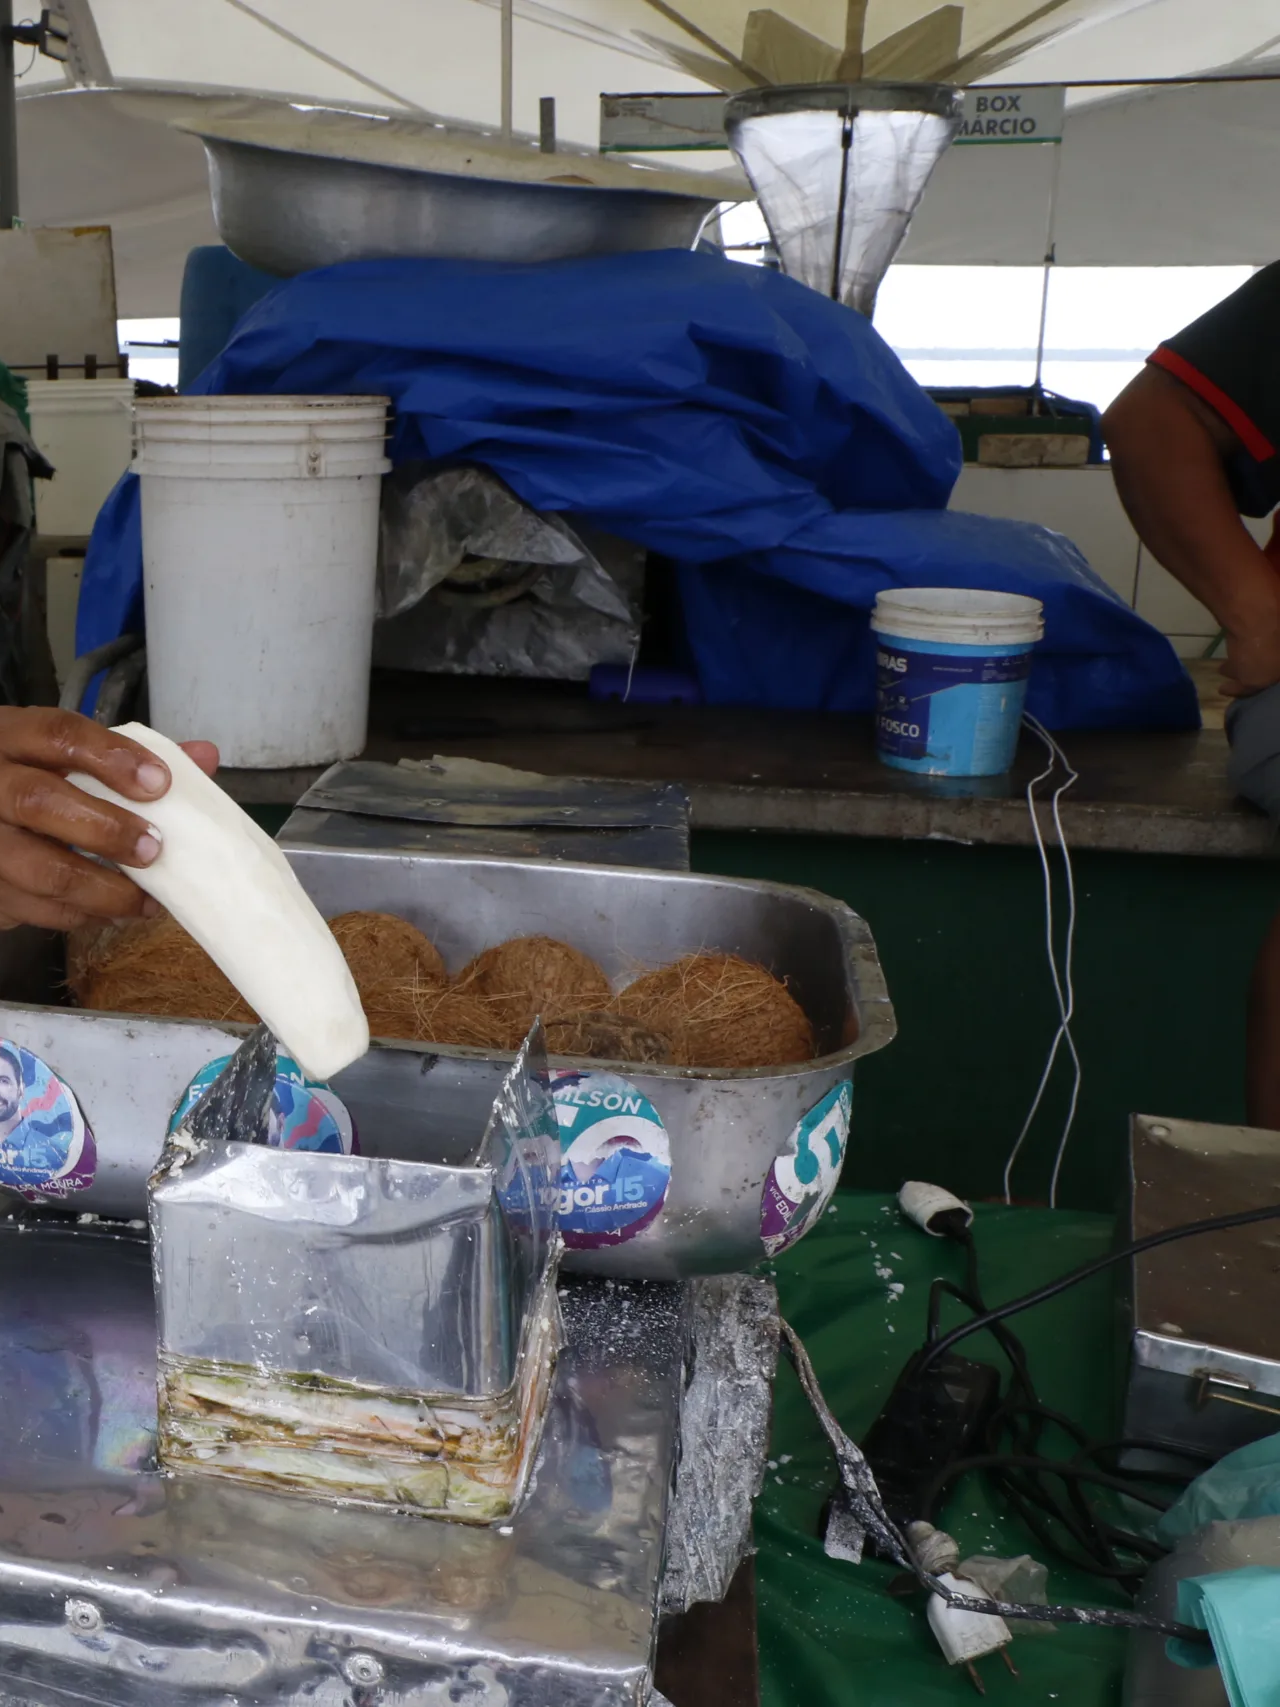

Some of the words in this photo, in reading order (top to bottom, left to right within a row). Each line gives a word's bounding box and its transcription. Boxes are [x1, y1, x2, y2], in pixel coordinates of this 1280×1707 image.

[976, 96, 1022, 113] BOX
[23, 1146, 48, 1168] 15
[41, 1178, 83, 1191] MOURA
[558, 1183, 610, 1215] gor
[611, 1175, 645, 1202] 15
[769, 1185, 782, 1201] VICE
[613, 1200, 648, 1211] Andrade
